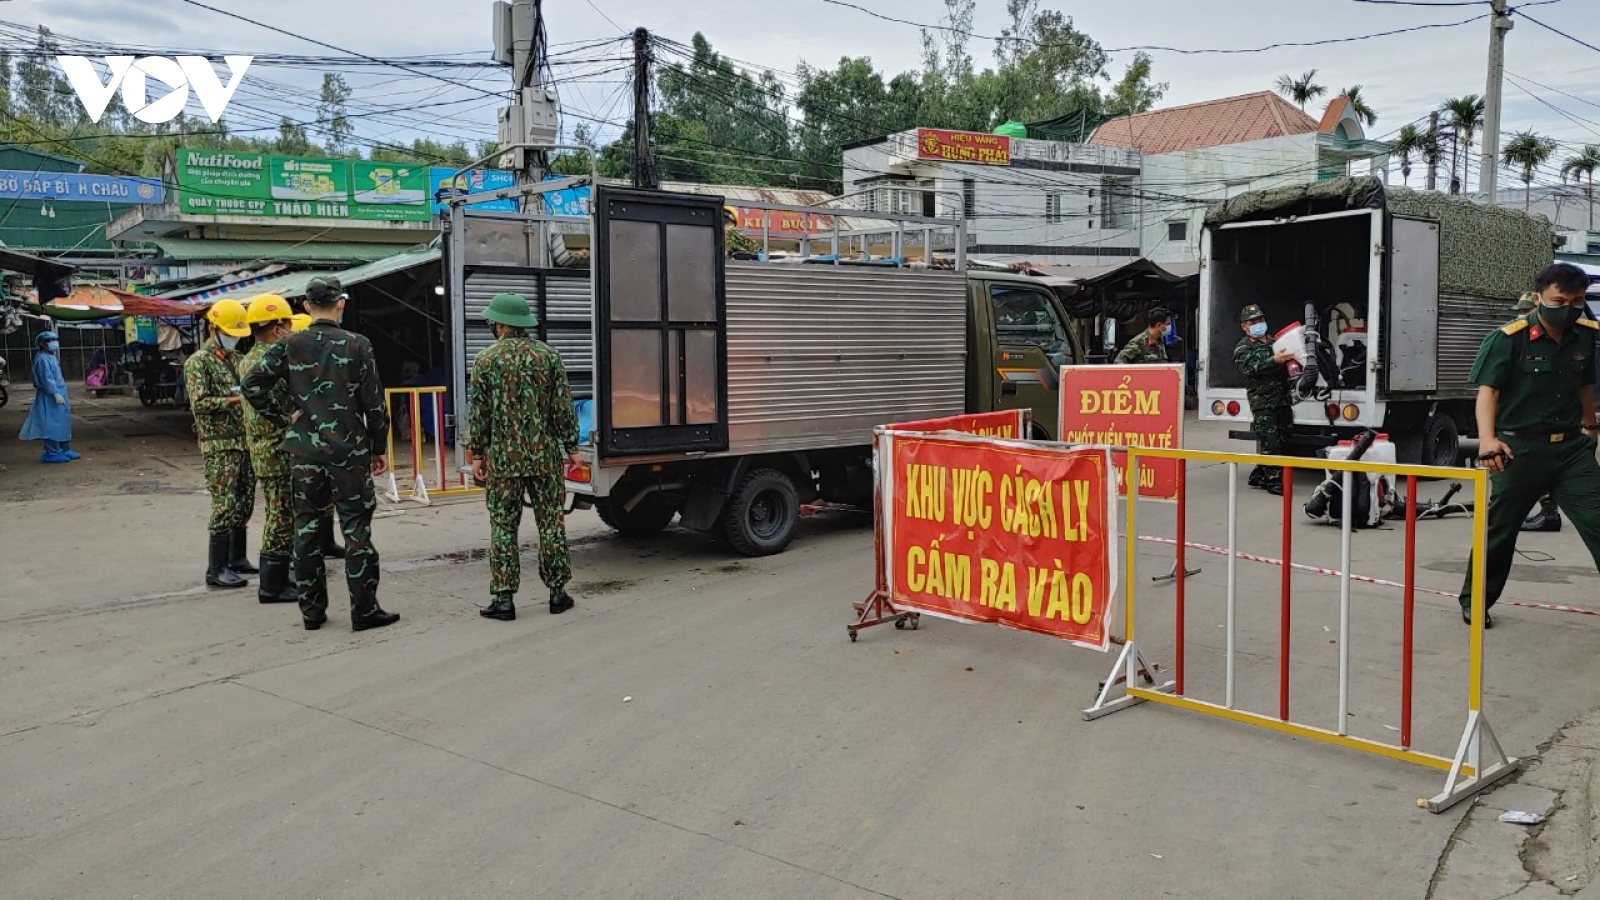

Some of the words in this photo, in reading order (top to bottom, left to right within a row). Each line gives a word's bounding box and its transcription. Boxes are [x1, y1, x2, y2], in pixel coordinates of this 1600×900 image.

[185, 152, 263, 170] NutiFood
[92, 180, 129, 197] CHÂU
[1080, 374, 1161, 415] ĐIỂM
[1067, 423, 1095, 445] CHỐT
[1125, 432, 1145, 448] TRA
[1148, 433, 1156, 448] Y
[1159, 425, 1173, 449] TẾ
[906, 463, 946, 523] KHU
[952, 464, 993, 540] VỰC
[1000, 464, 1058, 539] CÁCH
[1062, 480, 1090, 542] LY
[907, 533, 971, 602] CẤM
[980, 558, 1017, 613] RA
[1028, 558, 1093, 625] VÀO
